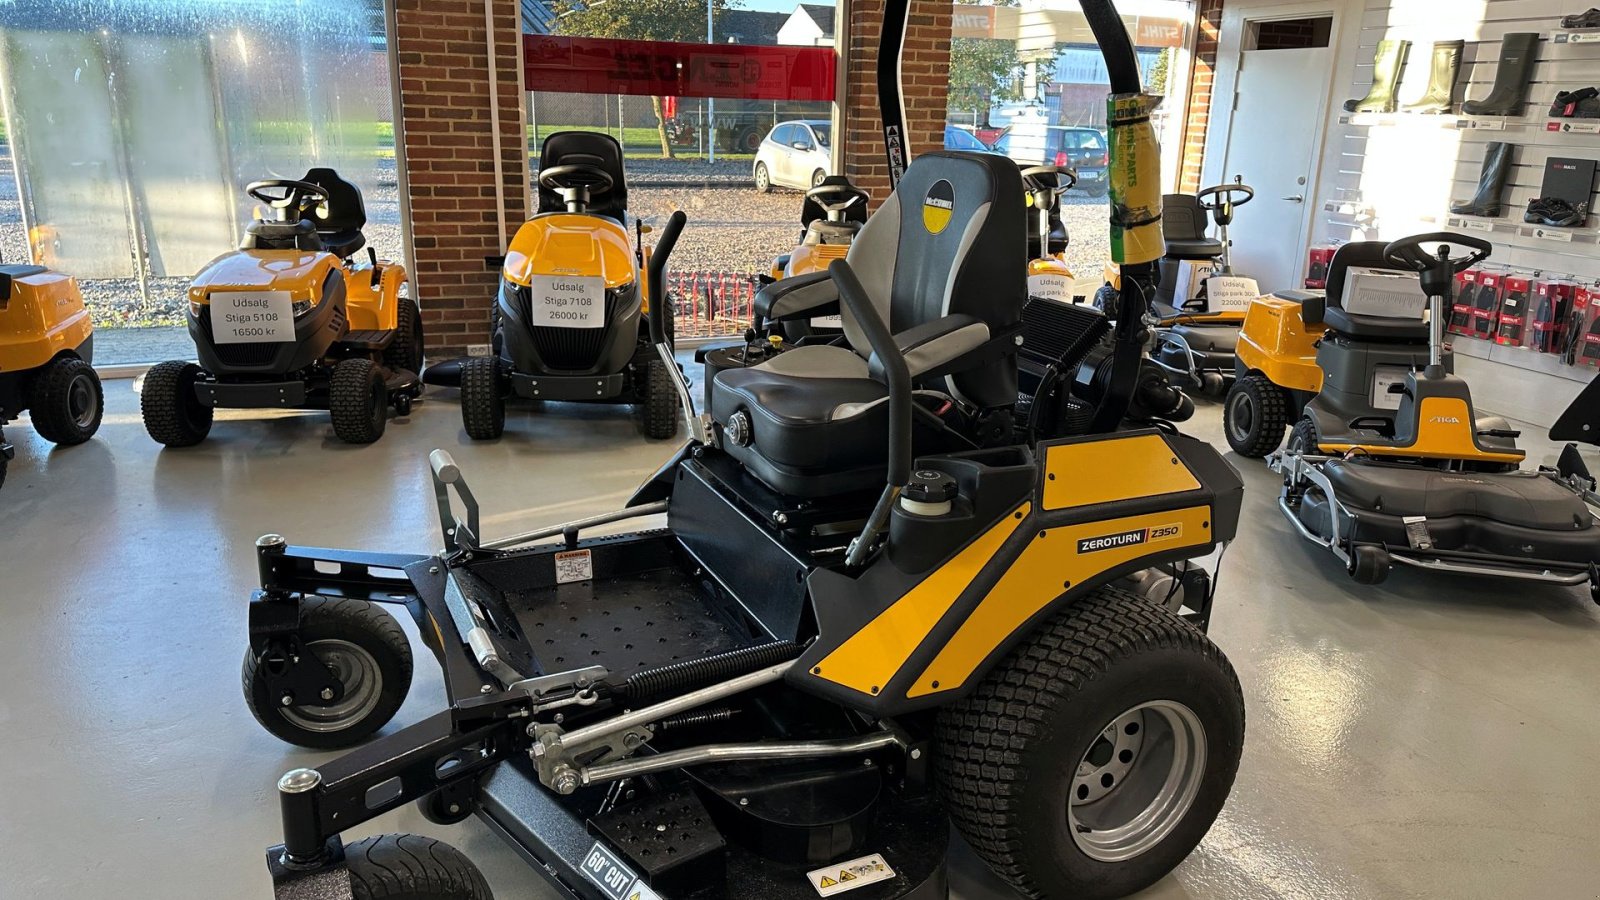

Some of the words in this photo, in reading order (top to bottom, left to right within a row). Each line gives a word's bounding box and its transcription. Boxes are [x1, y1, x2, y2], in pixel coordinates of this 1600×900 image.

[1126, 153, 1137, 188] PARTS
[551, 282, 585, 293] Udsalg
[1040, 279, 1065, 288] Udsalg
[1222, 281, 1246, 289] Udsalg
[232, 298, 269, 309] Udsalg
[544, 296, 568, 307] Stiga
[570, 297, 592, 306] 7108
[225, 312, 251, 323] Stiga
[253, 312, 279, 322] 5108
[549, 311, 578, 320] 26000
[579, 311, 589, 320] kr
[232, 327, 264, 337] 16500
[265, 327, 276, 336] kr
[1429, 416, 1460, 424] STIGA
[1081, 532, 1141, 551] ZEROTURN
[1151, 526, 1179, 539] Z350
[564, 551, 588, 559] WARNING
[587, 851, 611, 873] 60"
[604, 866, 630, 893] CUT
